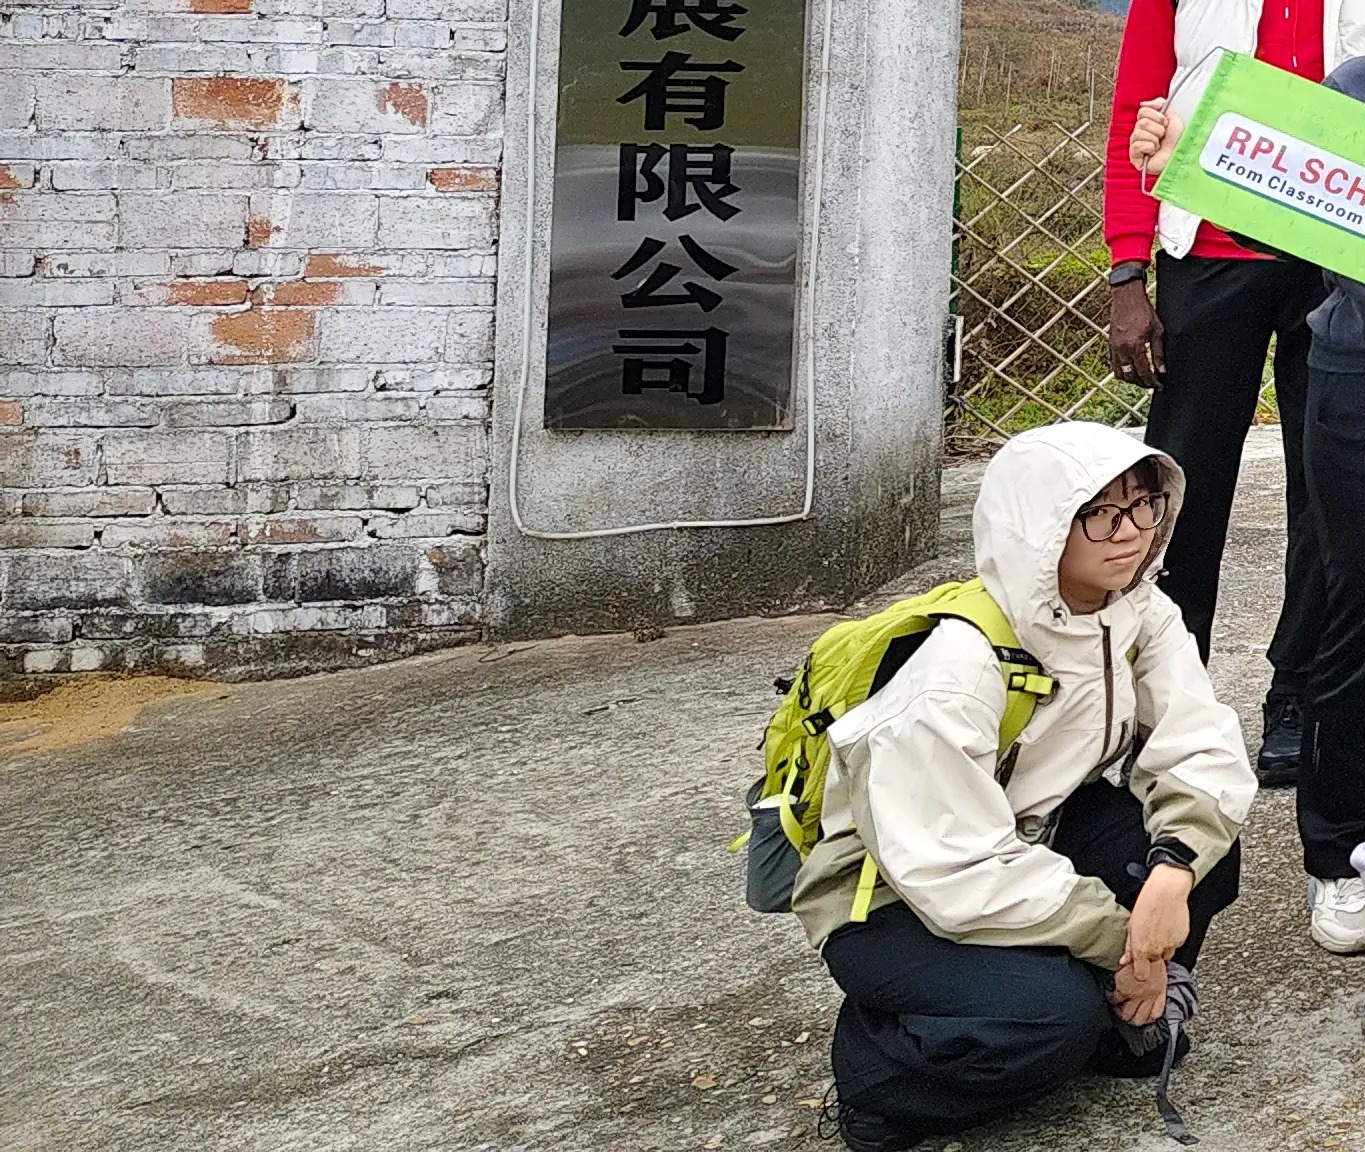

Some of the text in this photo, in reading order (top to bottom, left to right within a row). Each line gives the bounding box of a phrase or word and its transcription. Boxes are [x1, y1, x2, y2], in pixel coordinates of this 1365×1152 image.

[1225, 126, 1289, 175] RPL
[1215, 154, 1263, 185] From
[1268, 175, 1364, 224] Classroom
